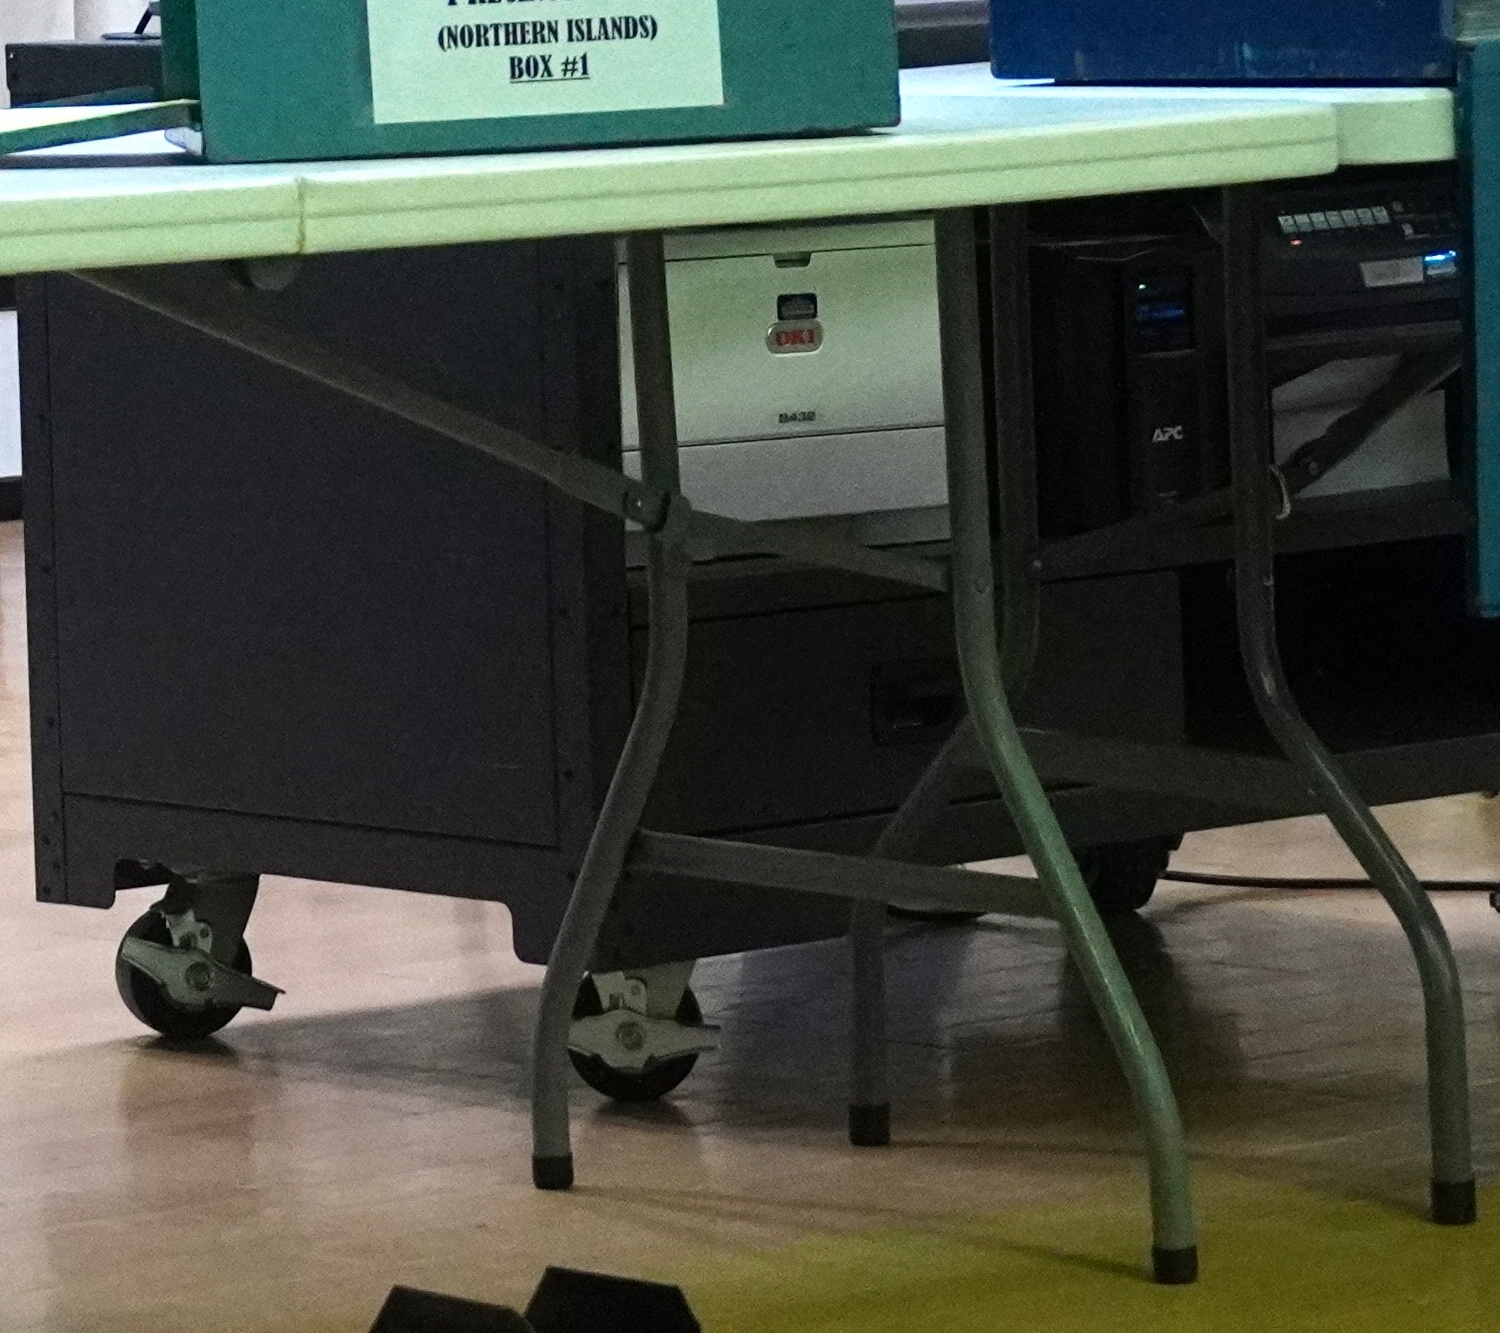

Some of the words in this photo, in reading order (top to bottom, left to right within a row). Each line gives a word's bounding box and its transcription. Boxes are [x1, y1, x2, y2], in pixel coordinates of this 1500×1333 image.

[437, 19, 559, 52] (NORTHERN
[566, 14, 658, 43] ISLANDS)
[509, 54, 553, 80] BOX
[560, 52, 590, 78] #1
